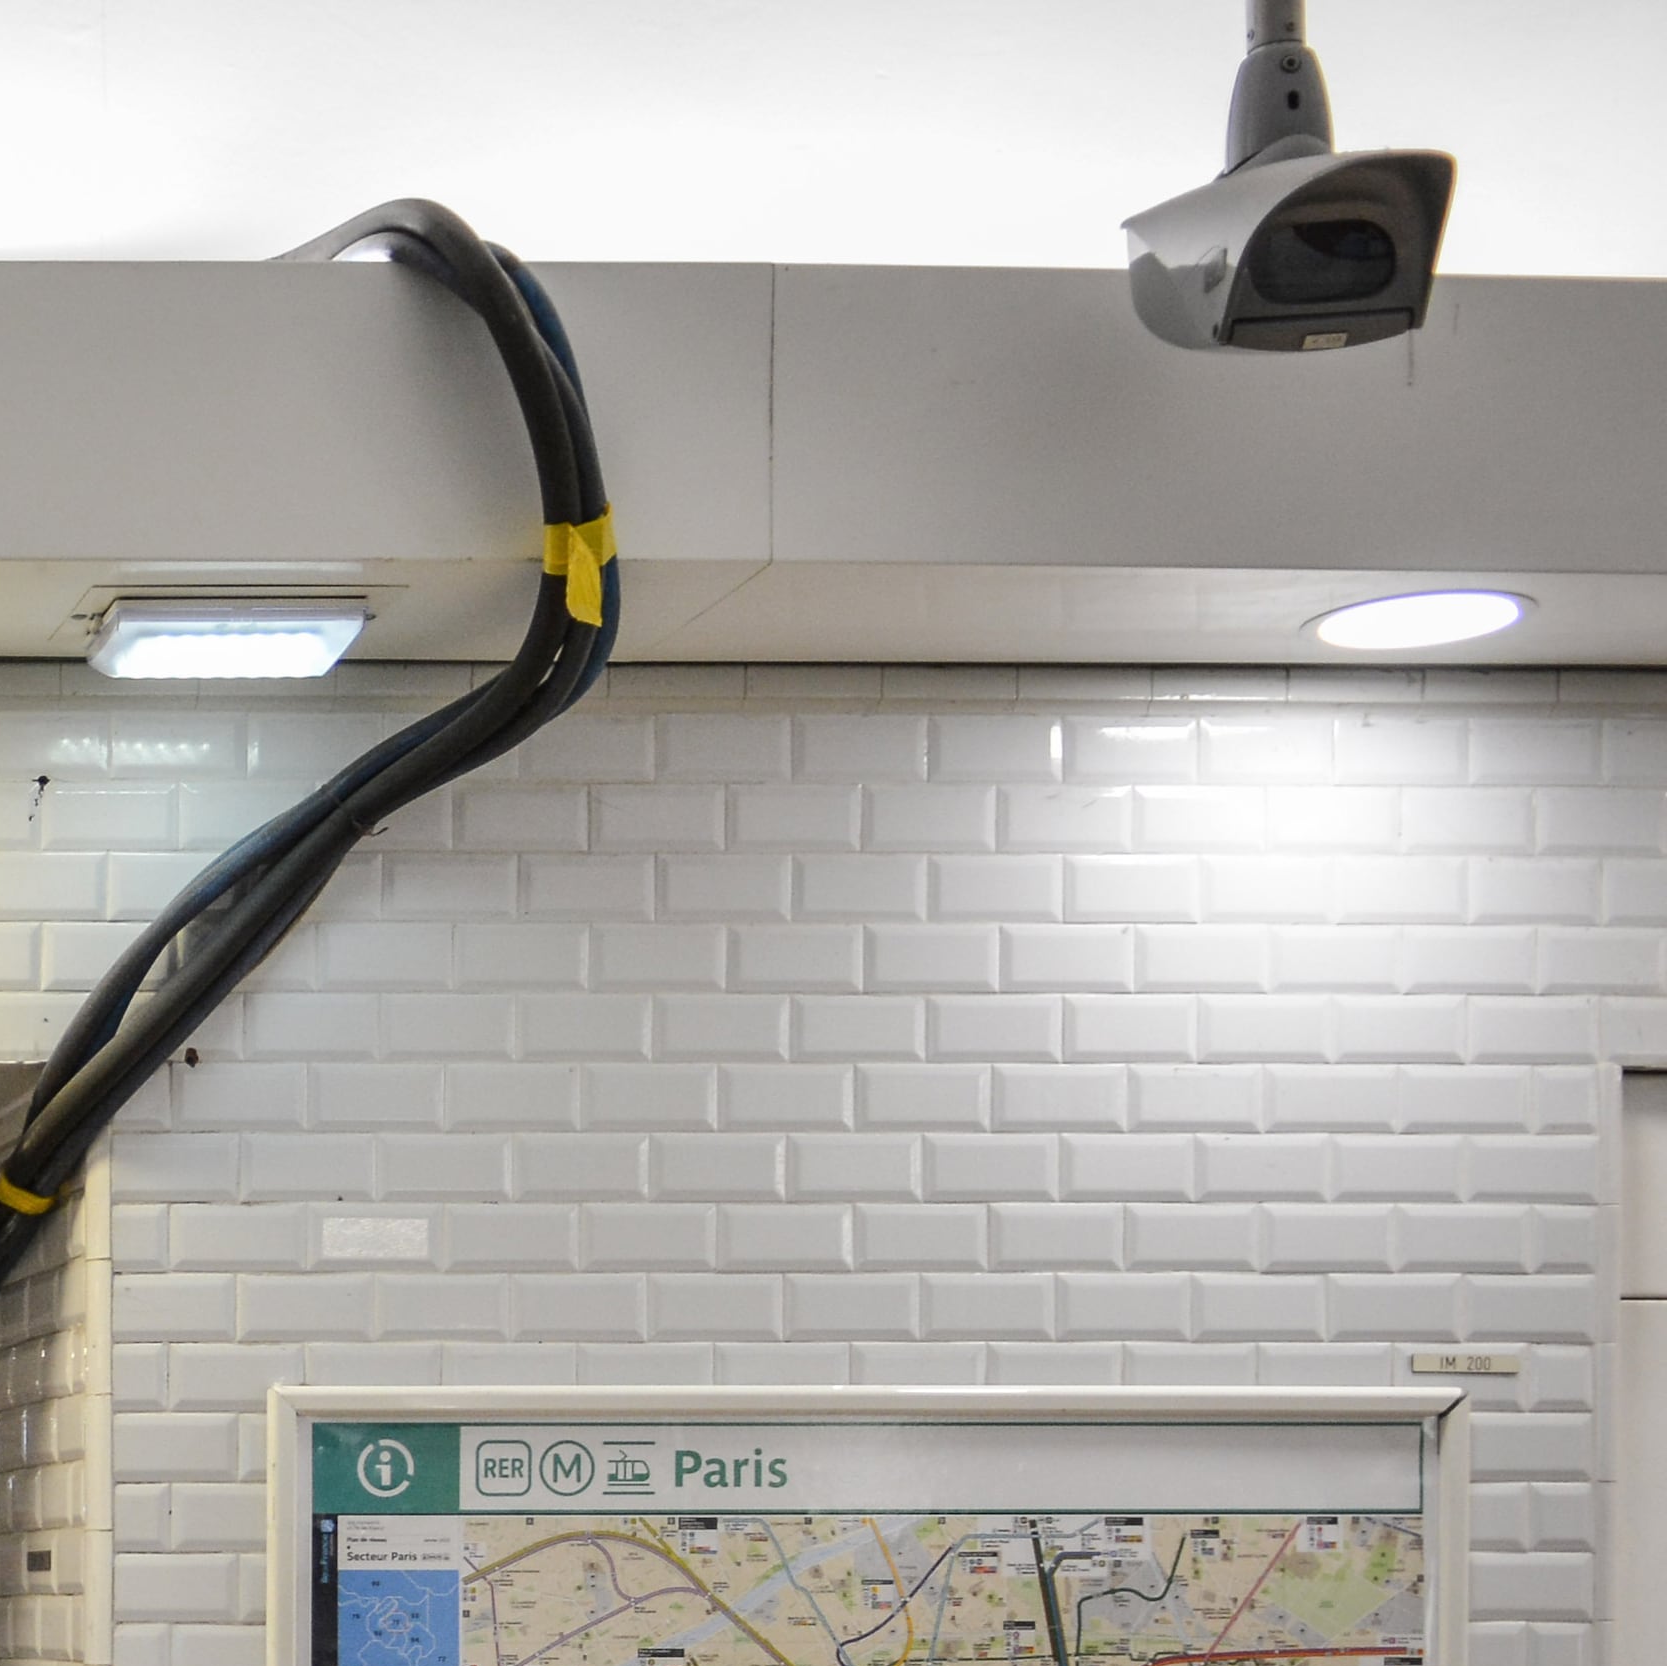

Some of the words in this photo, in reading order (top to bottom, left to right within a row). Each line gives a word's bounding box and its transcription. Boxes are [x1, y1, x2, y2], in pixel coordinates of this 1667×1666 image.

[483, 1457, 525, 1479] RER
[552, 1453, 582, 1481] M
[673, 1449, 789, 1488] Paris
[346, 1551, 388, 1562] Secteur
[391, 1551, 418, 1562] Paris
